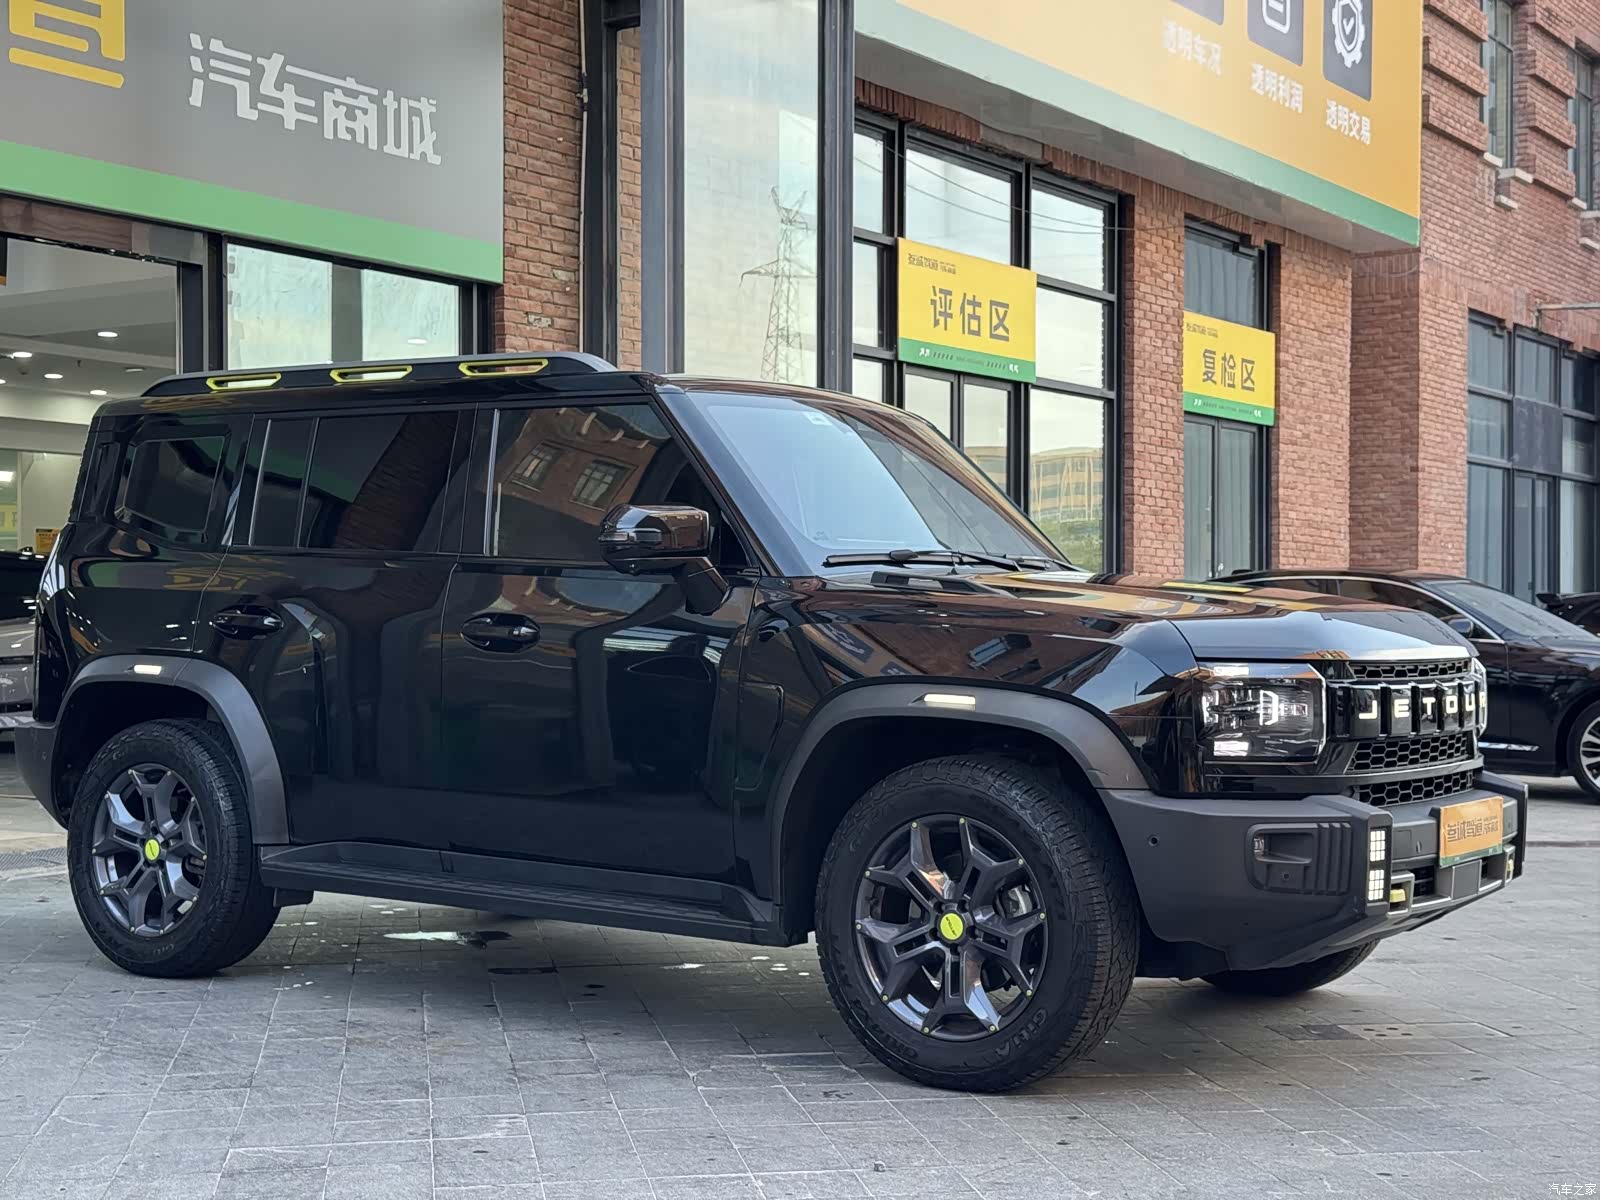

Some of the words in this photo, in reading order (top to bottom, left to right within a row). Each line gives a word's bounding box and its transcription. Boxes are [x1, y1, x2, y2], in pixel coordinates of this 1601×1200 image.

[1163, 20, 1222, 76] 透明车况
[189, 33, 441, 165] 汽车商城
[1250, 63, 1303, 113] 透明利润
[1326, 98, 1371, 145] 透明交易
[930, 285, 1010, 342] 评估区
[1203, 349, 1256, 392] 复检区
